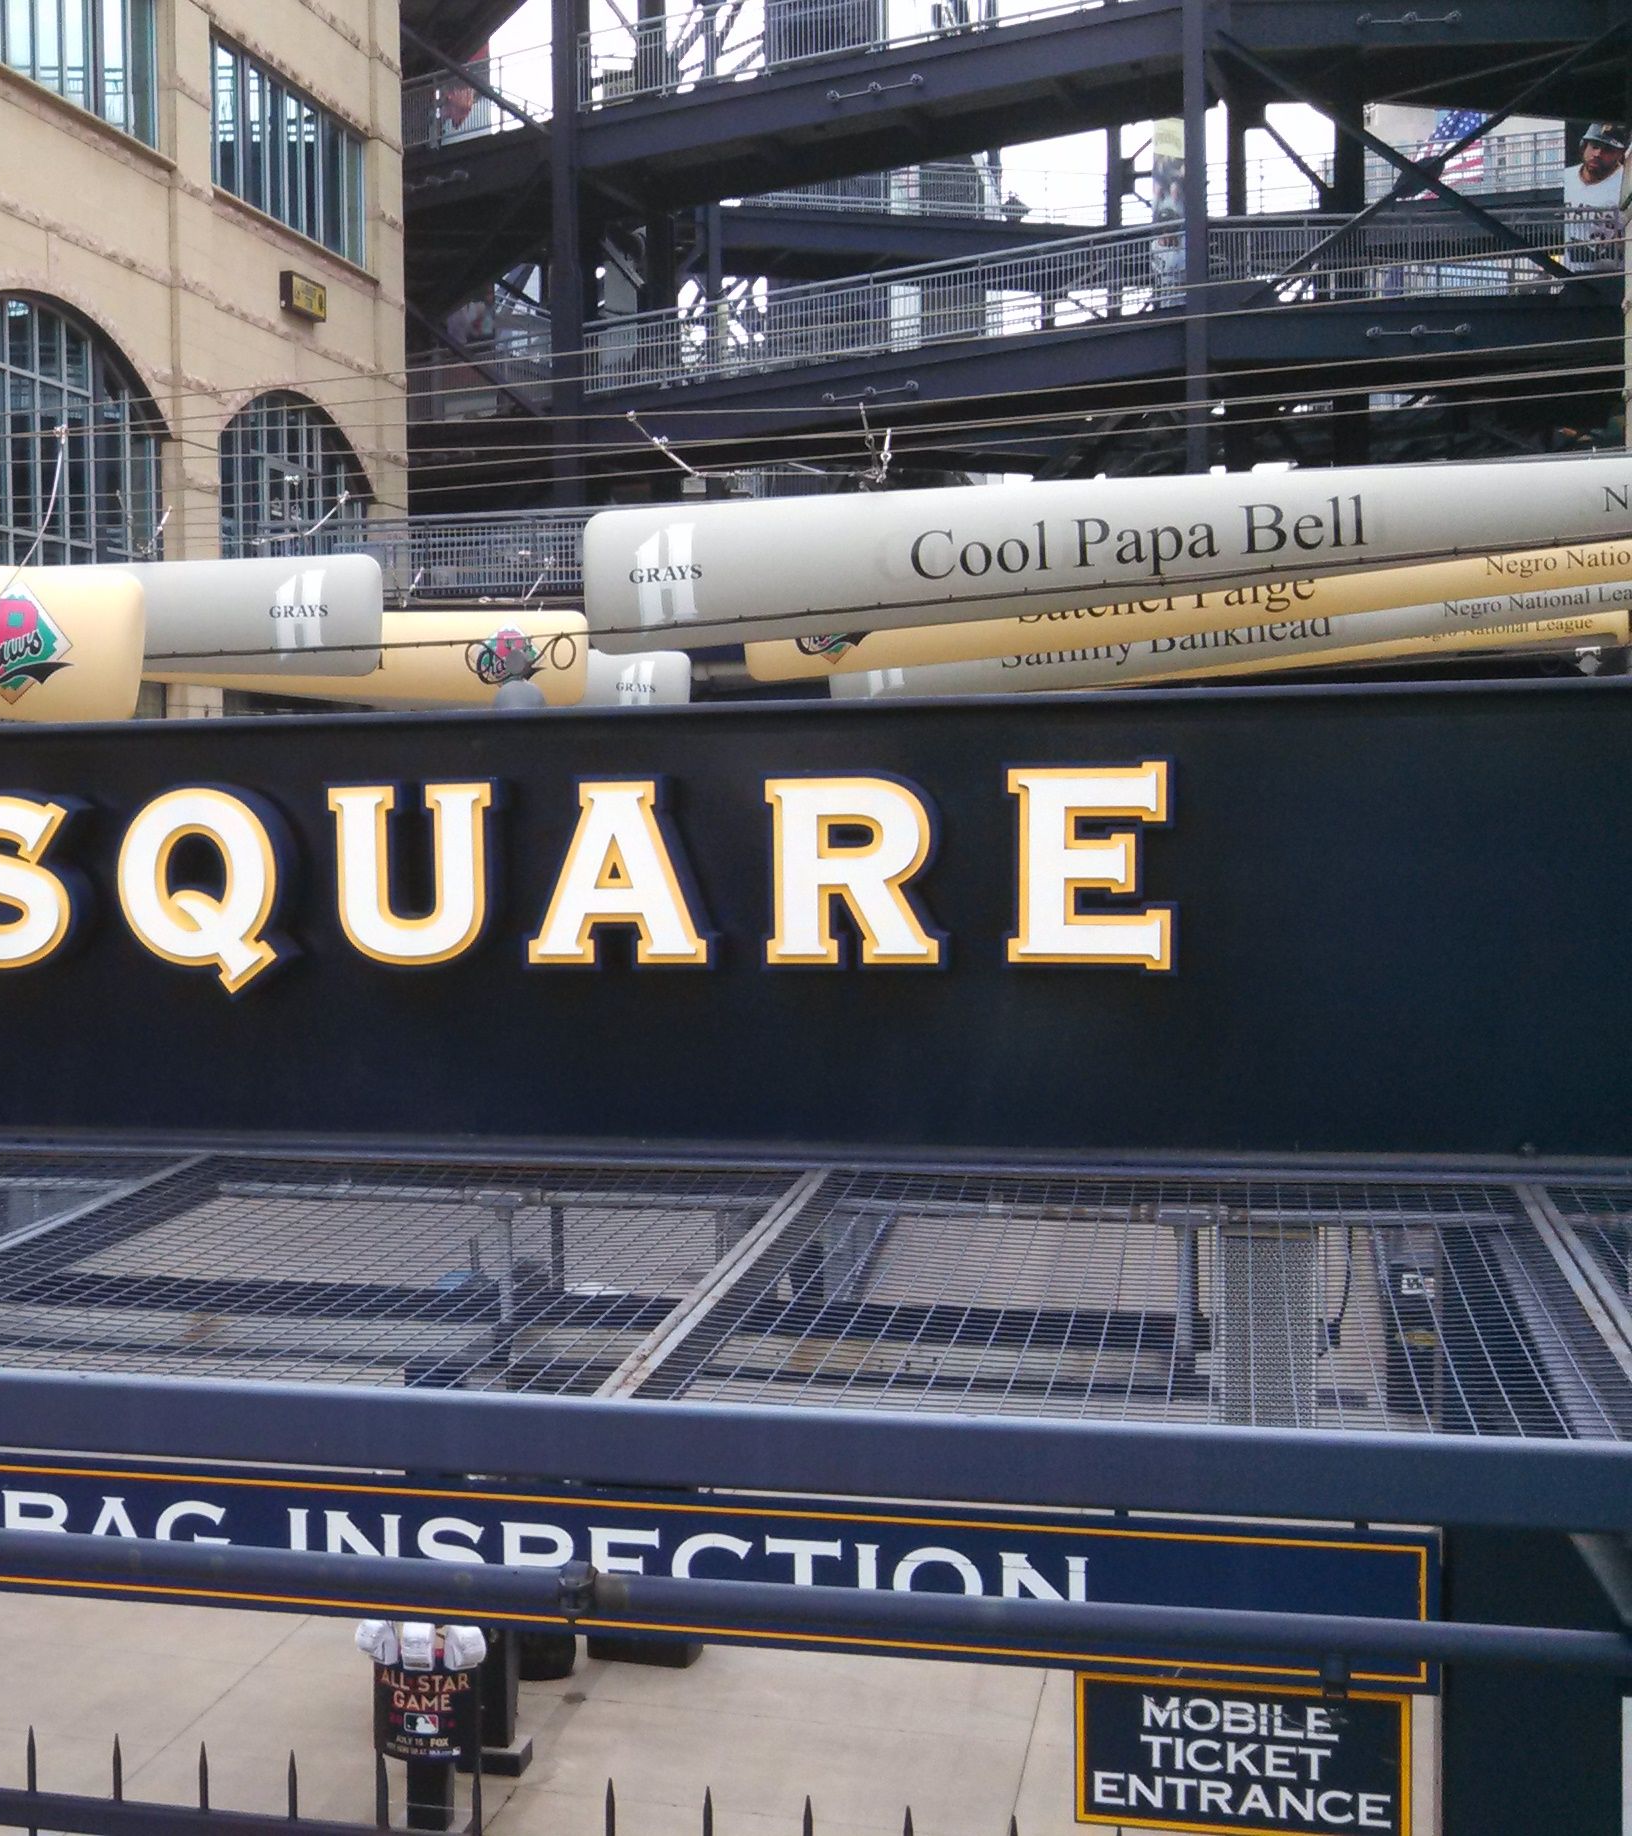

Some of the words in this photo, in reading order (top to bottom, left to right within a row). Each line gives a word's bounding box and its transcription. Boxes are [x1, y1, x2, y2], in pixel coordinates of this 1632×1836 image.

[911, 520, 1052, 580] Cool
[1073, 518, 1220, 576] Papa
[1239, 495, 1368, 555] Bell
[629, 564, 703, 585] GRAYS
[1485, 555, 1557, 579] Negro
[269, 604, 328, 619] GRAYS
[1444, 600, 1502, 620] Negro
[1509, 587, 1591, 612] National
[615, 681, 657, 693] GRAYS
[1, 1490, 231, 1545] BAG
[287, 1508, 1089, 1602] INSPECTION
[381, 1668, 410, 1691] ALL
[418, 1673, 470, 1693] STAR
[393, 1690, 452, 1711] GAME
[1142, 1694, 1339, 1742] MOBILE
[1140, 1734, 1331, 1782] TICKET
[1093, 1771, 1392, 1829] ENTRANCE
